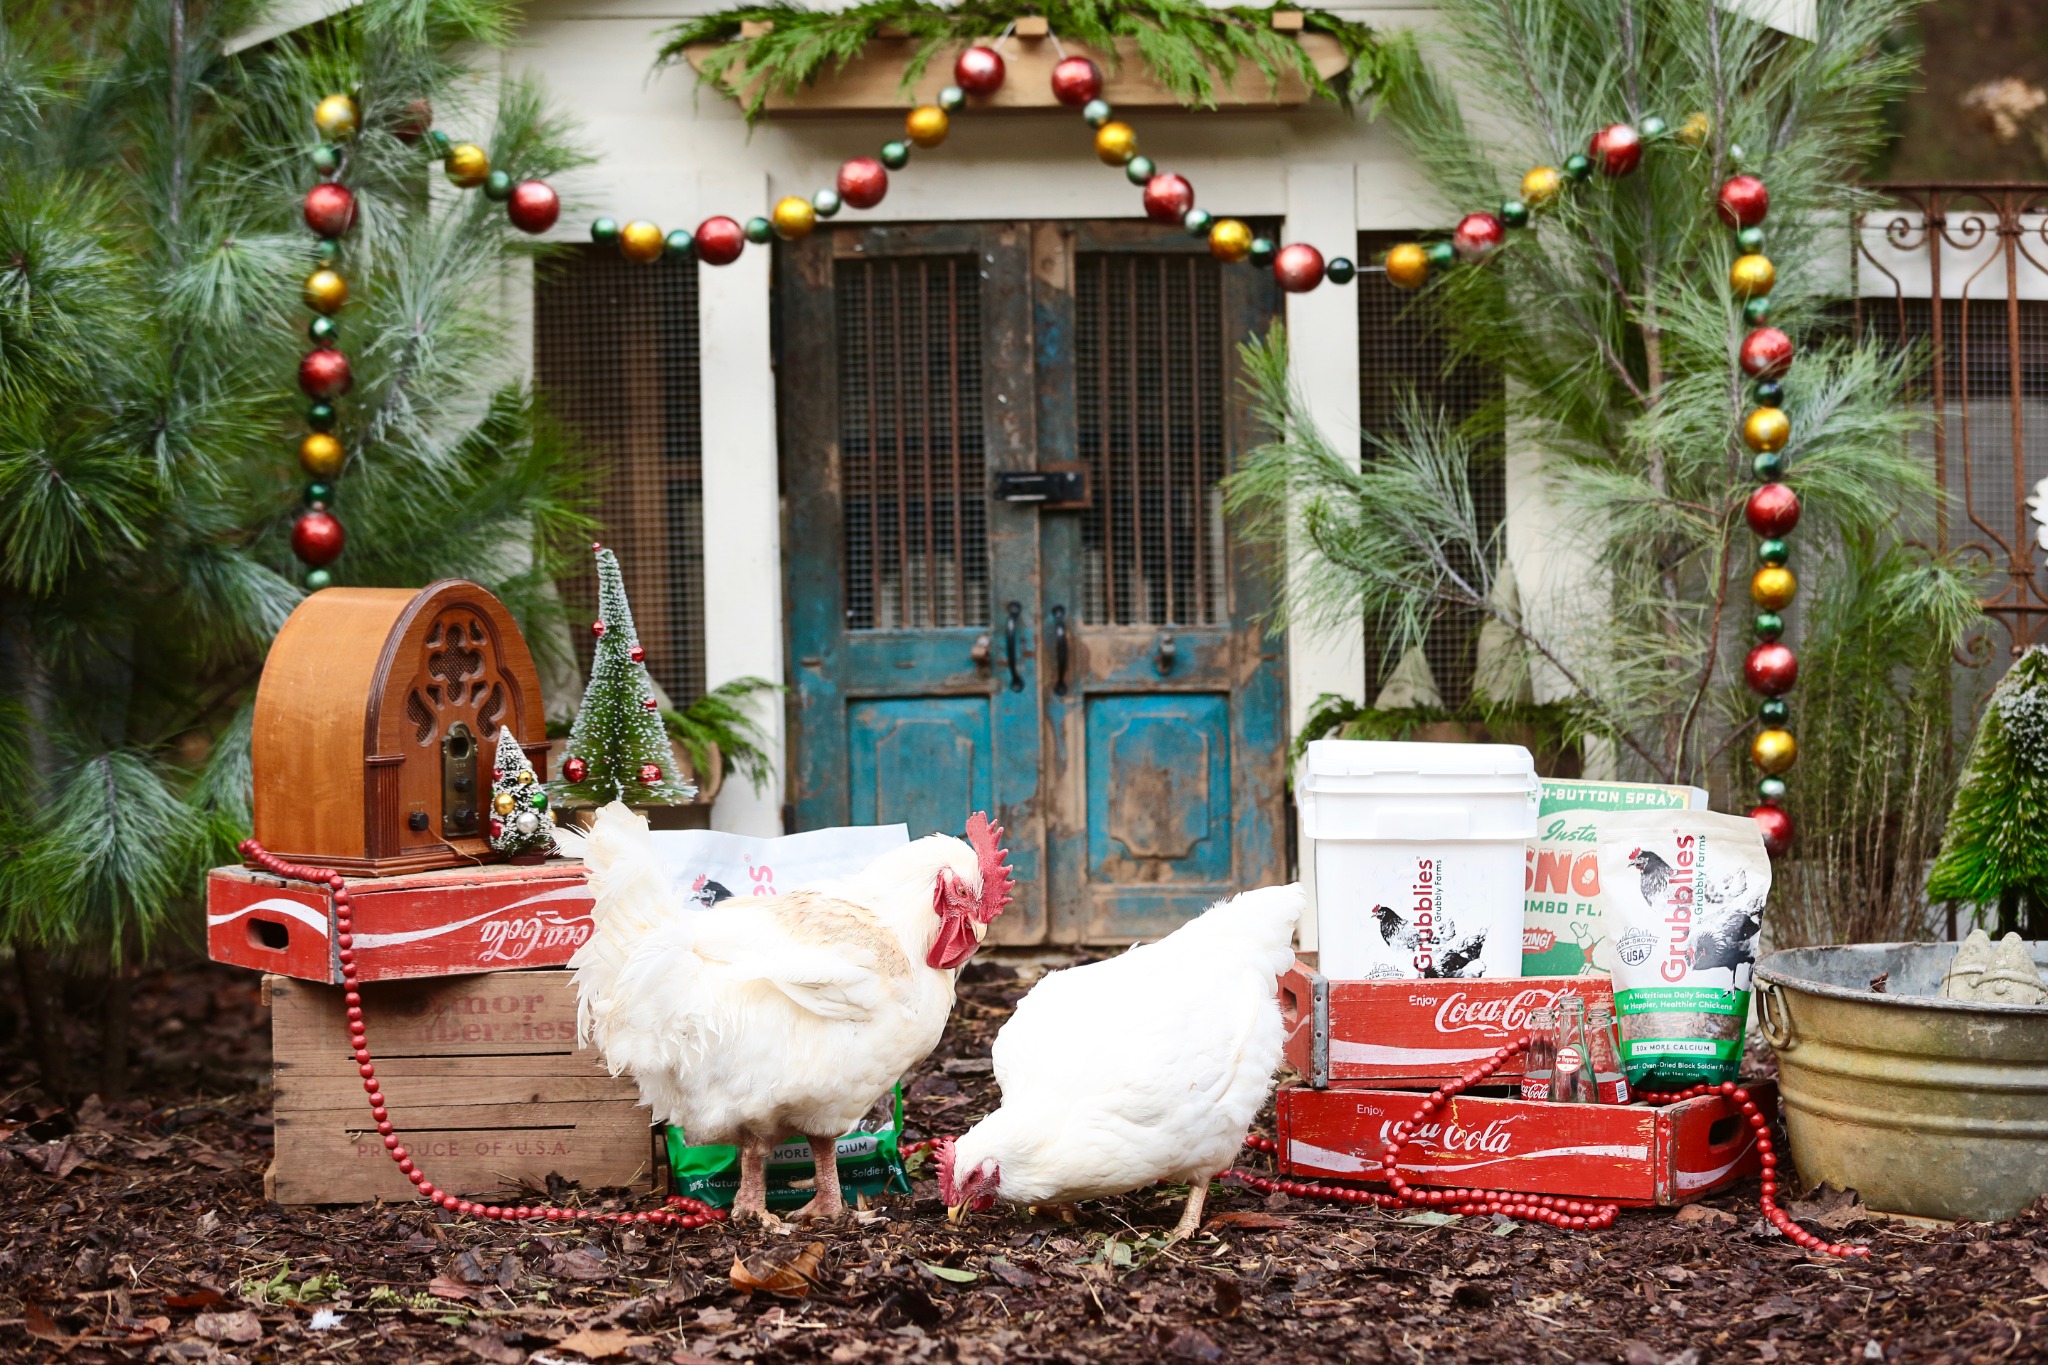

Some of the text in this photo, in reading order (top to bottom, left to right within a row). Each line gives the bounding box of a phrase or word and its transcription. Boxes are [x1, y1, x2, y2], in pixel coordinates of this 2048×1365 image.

[1625, 792, 1678, 807] SPRAY
[1541, 819, 1597, 843] Insta
[1696, 835, 1706, 867] Farms
[1694, 871, 1706, 916] Grubbly
[1435, 888, 1444, 922] Grubbly
[1524, 900, 1602, 917] MBO FL
[1661, 835, 1695, 982] Grubblies
[1413, 859, 1433, 973] Grubblies
[1523, 933, 1552, 949] ZING!
[1627, 949, 1645, 962] USA
[1409, 994, 1438, 1007] Enjoy
[1674, 992, 1694, 1000] Daily
[1630, 1002, 1659, 1010] Happier,
[1699, 1001, 1733, 1010] Chickens
[1697, 1062, 1719, 1070] Soldier
[1357, 1104, 1386, 1117] Enjoy
[475, 1142, 502, 1156] OF
[774, 1141, 868, 1160] MORE CIUM
[706, 1178, 742, 1188] Natur
[852, 1166, 884, 1178] Soldier
[777, 1187, 804, 1195] Weight
